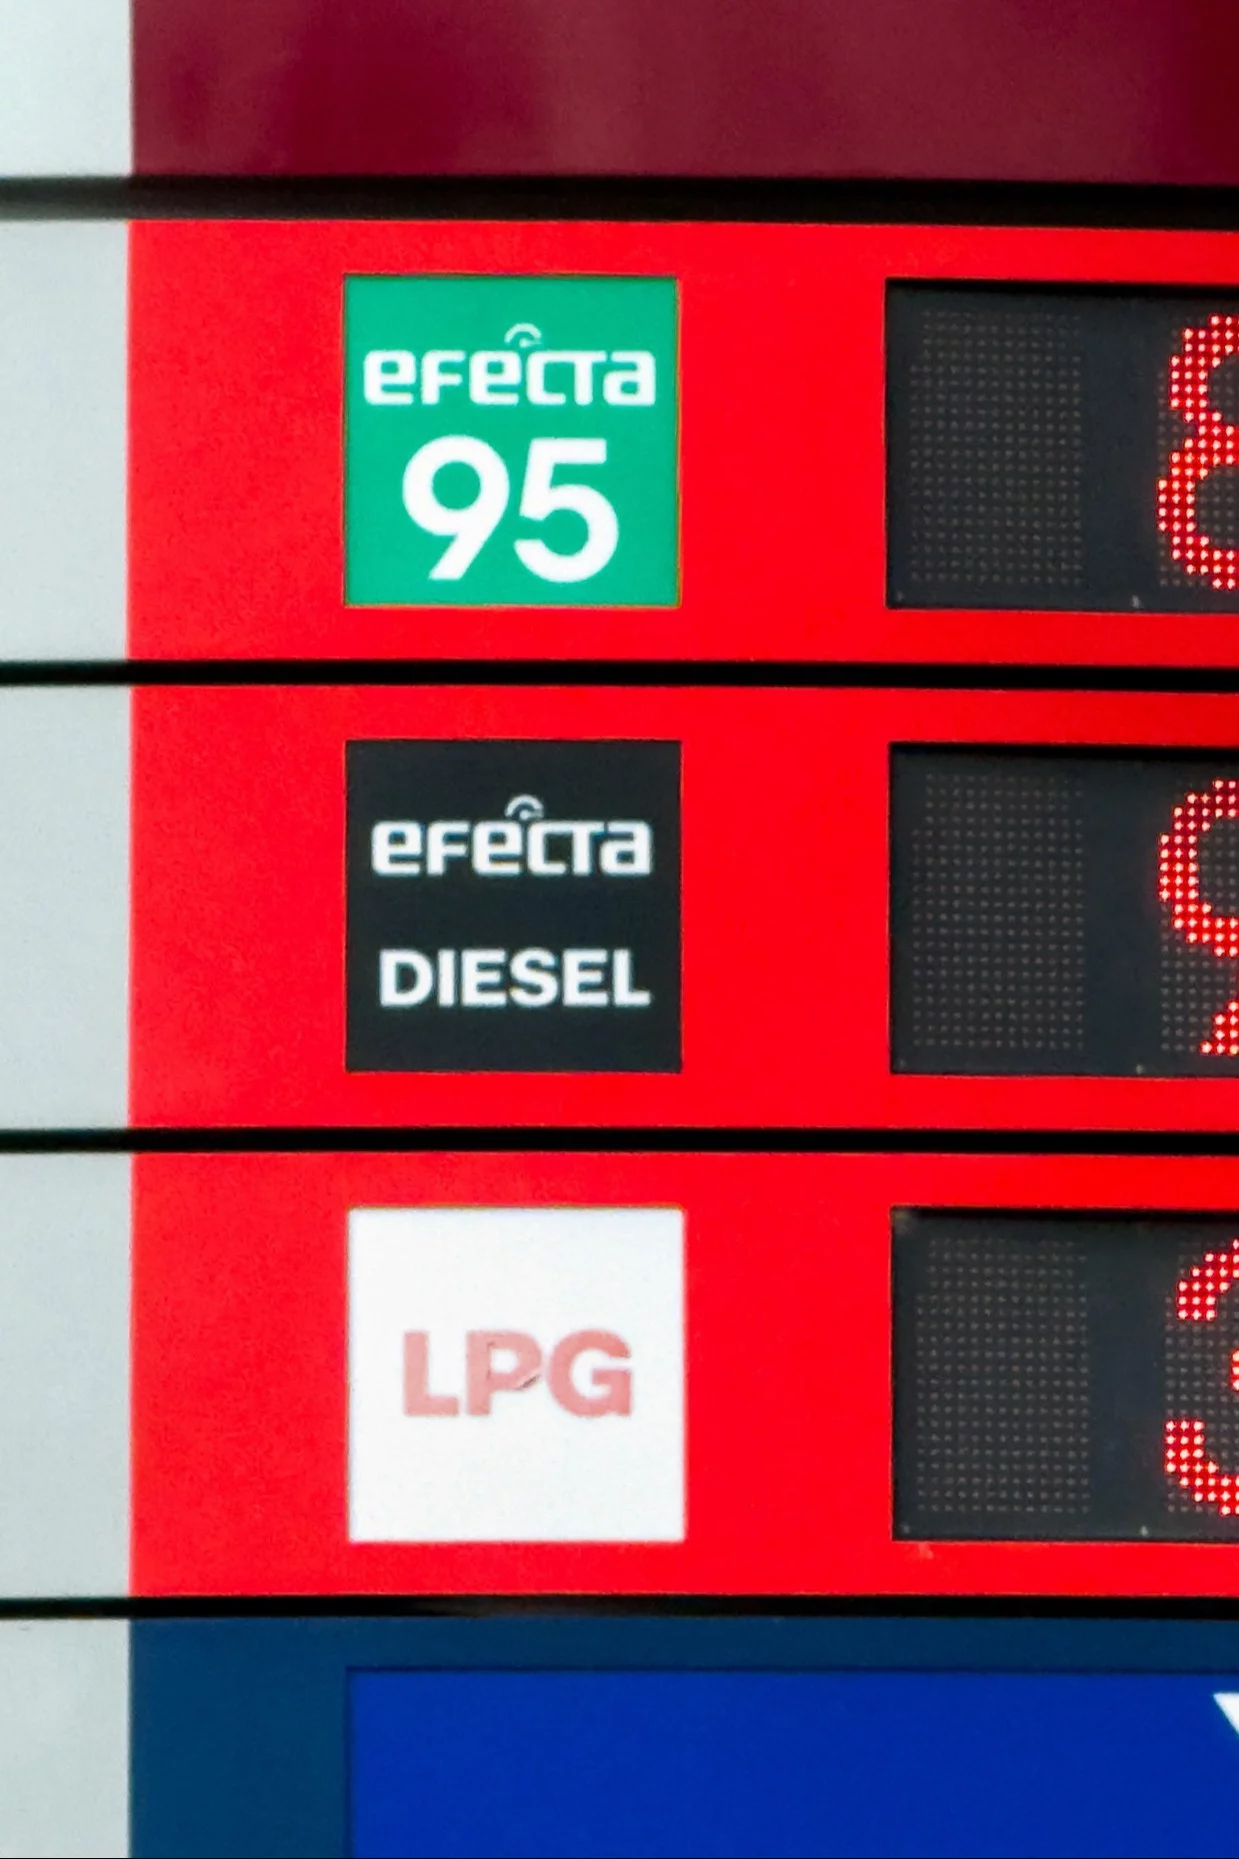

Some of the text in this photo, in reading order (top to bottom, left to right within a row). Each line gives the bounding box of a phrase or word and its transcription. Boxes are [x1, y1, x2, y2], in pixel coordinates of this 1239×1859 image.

[402, 434, 619, 583] 95
[379, 947, 652, 1007] DIESEL
[403, 1329, 633, 1418] LPG
